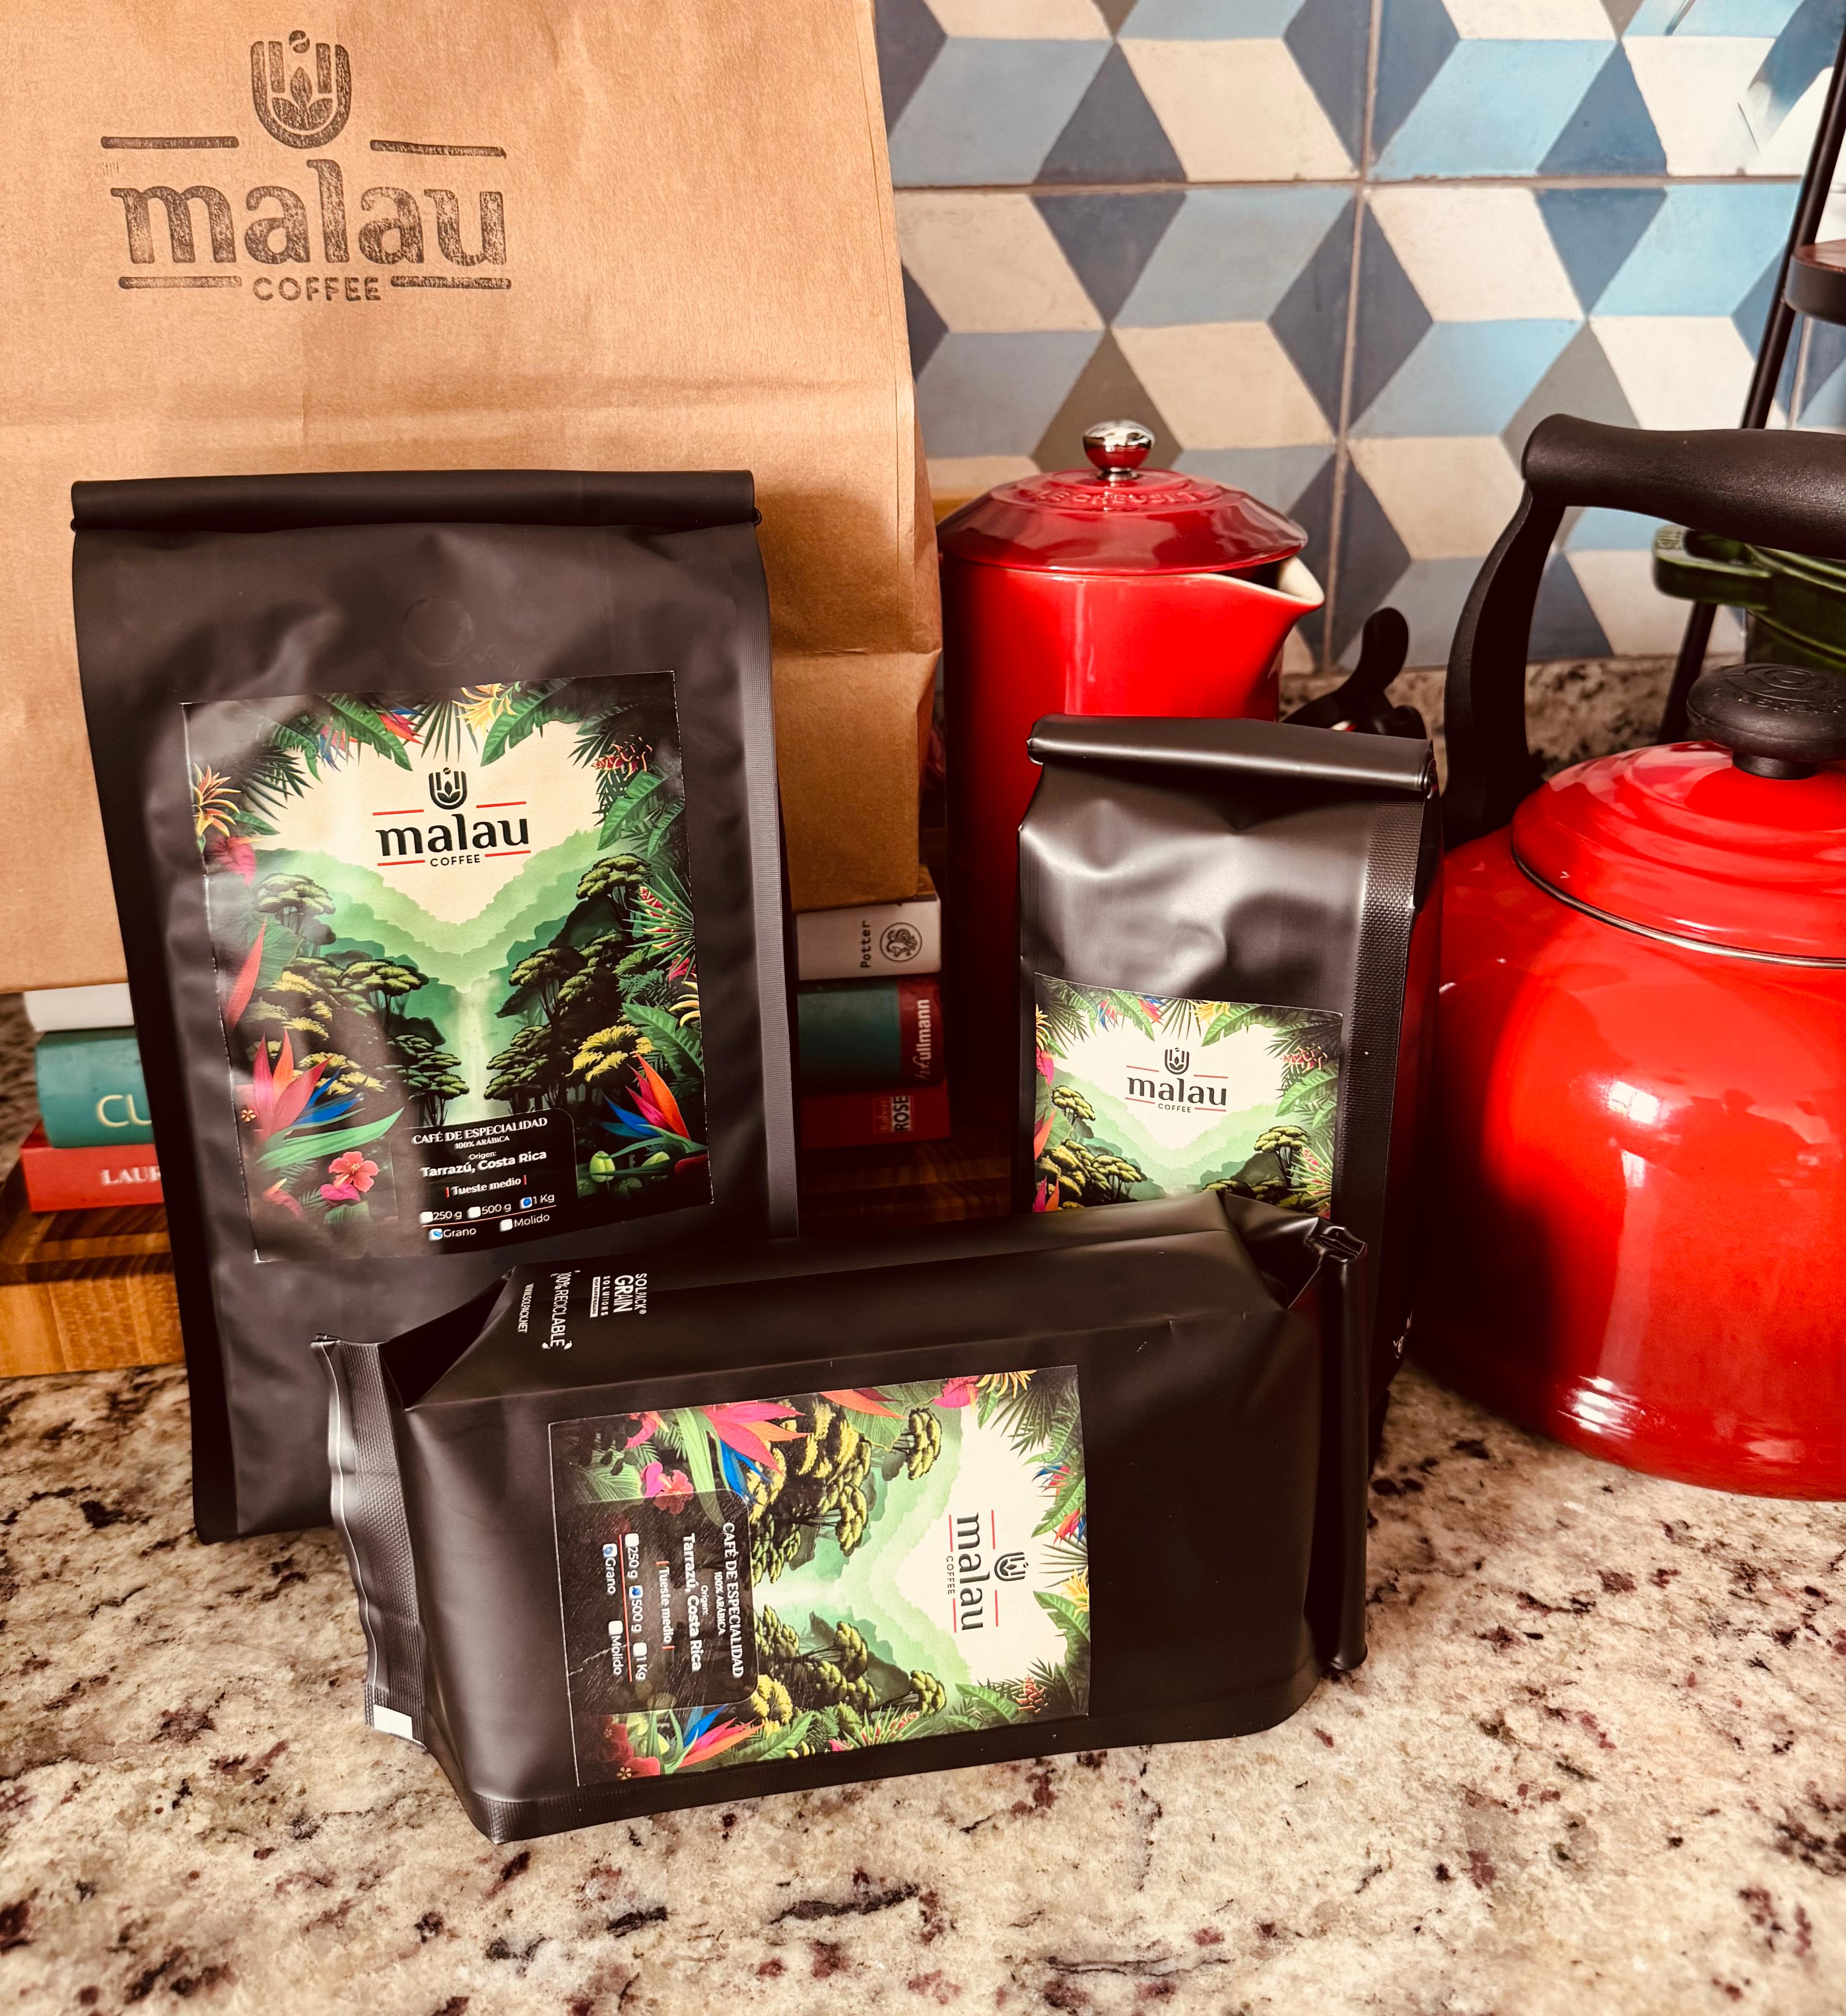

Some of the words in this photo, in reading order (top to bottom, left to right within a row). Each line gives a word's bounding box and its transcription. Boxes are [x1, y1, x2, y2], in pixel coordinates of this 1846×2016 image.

[110, 159, 506, 267] malau
[253, 277, 382, 302] COFFEE
[376, 813, 529, 856] malau
[430, 854, 481, 867] COFFEE
[861, 921, 872, 969] Potter
[1127, 1077, 1227, 1105] malau
[893, 1096, 910, 1132] ROSE
[1158, 1103, 1191, 1113] COFFEE
[412, 1131, 443, 1145] CAFÉ
[445, 1130, 463, 1142] DE
[464, 1118, 548, 1139] ESPECIALIDAD
[455, 1141, 475, 1150] 100%
[475, 1135, 510, 1146] ARÁBICA
[419, 1162, 475, 1178] Tarrazú,
[477, 1157, 516, 1171] Costa
[519, 1150, 547, 1164] Rica
[468, 1151, 497, 1161] Origen:
[451, 1183, 488, 1196] Tueste
[489, 1178, 521, 1190] medio
[532, 1197, 537, 1205] 1
[540, 1194, 555, 1203] Kg
[433, 1211, 453, 1220] 250
[482, 1205, 502, 1215] 500
[503, 1204, 512, 1213] g
[514, 1213, 550, 1228] Molido
[443, 1227, 477, 1238] Grano
[600, 1276, 611, 1316] SOLUTIONS
[613, 1275, 634, 1313] GRAIN
[550, 1289, 569, 1347] RECICLABLE
[723, 1522, 739, 1558] CAFÉ
[627, 1546, 640, 1569] 250
[682, 1532, 699, 1593] Tarrazú,
[725, 1559, 738, 1581] DE
[957, 1512, 990, 1631] malau
[605, 1557, 616, 1595] Grano
[627, 1570, 638, 1579] g
[659, 1566, 671, 1606] Tueste
[714, 1571, 724, 1597] 100%
[946, 1556, 955, 1594] COFFEE
[631, 1599, 644, 1622] 500
[700, 1584, 709, 1615] Origen:
[631, 1624, 642, 1633] g
[661, 1607, 675, 1644] medio
[687, 1595, 700, 1638] Costa
[715, 1595, 726, 1636] ARÁBICA
[726, 1581, 744, 1678] ESPECIALIDAD
[610, 1635, 624, 1676] Molido
[690, 1639, 704, 1672] Rica
[635, 1664, 648, 1682] Kg
